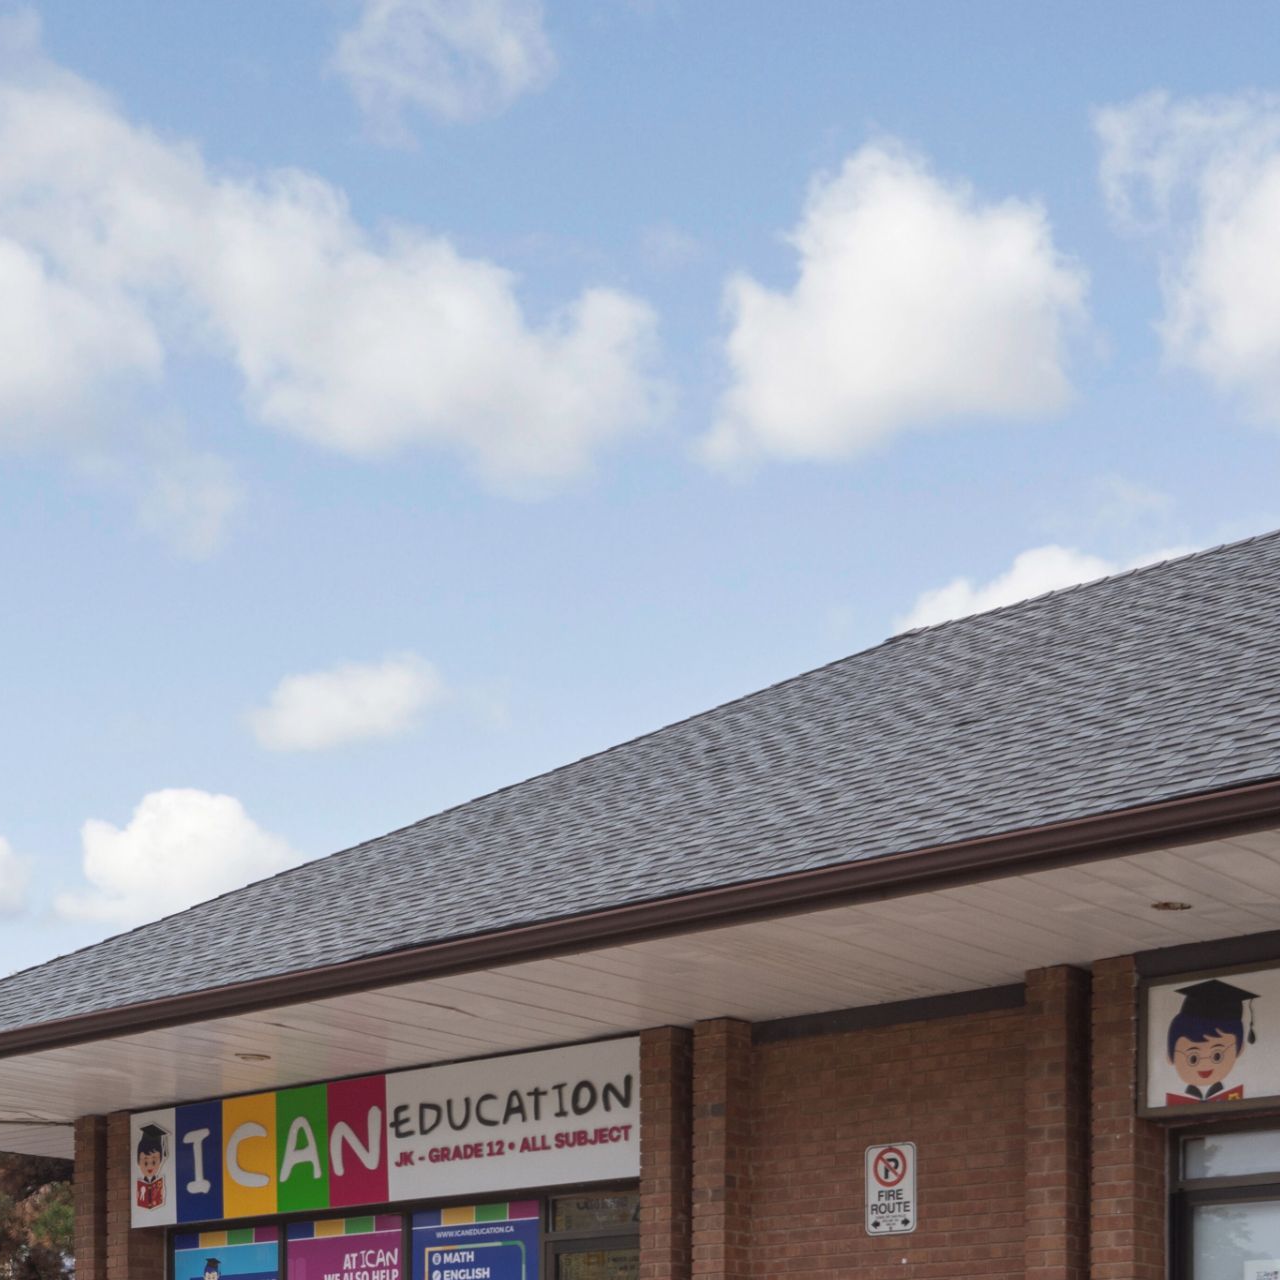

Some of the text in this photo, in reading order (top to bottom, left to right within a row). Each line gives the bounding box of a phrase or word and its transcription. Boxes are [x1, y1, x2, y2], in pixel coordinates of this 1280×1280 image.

[389, 1075, 633, 1140] EDUCATION
[395, 1150, 414, 1168] JK
[429, 1143, 484, 1164] GRADE
[487, 1141, 504, 1157] 12
[519, 1134, 551, 1153] ALL
[555, 1125, 632, 1149] SUBJECT
[878, 1189, 904, 1201] FIRE
[871, 1201, 911, 1215] ROUTE
[436, 1225, 515, 1238] WWW.ICANEDUCATION.CA
[343, 1247, 399, 1270] AT ICAN
[443, 1251, 475, 1264] MATH
[443, 1267, 490, 1280] ENGLISH
